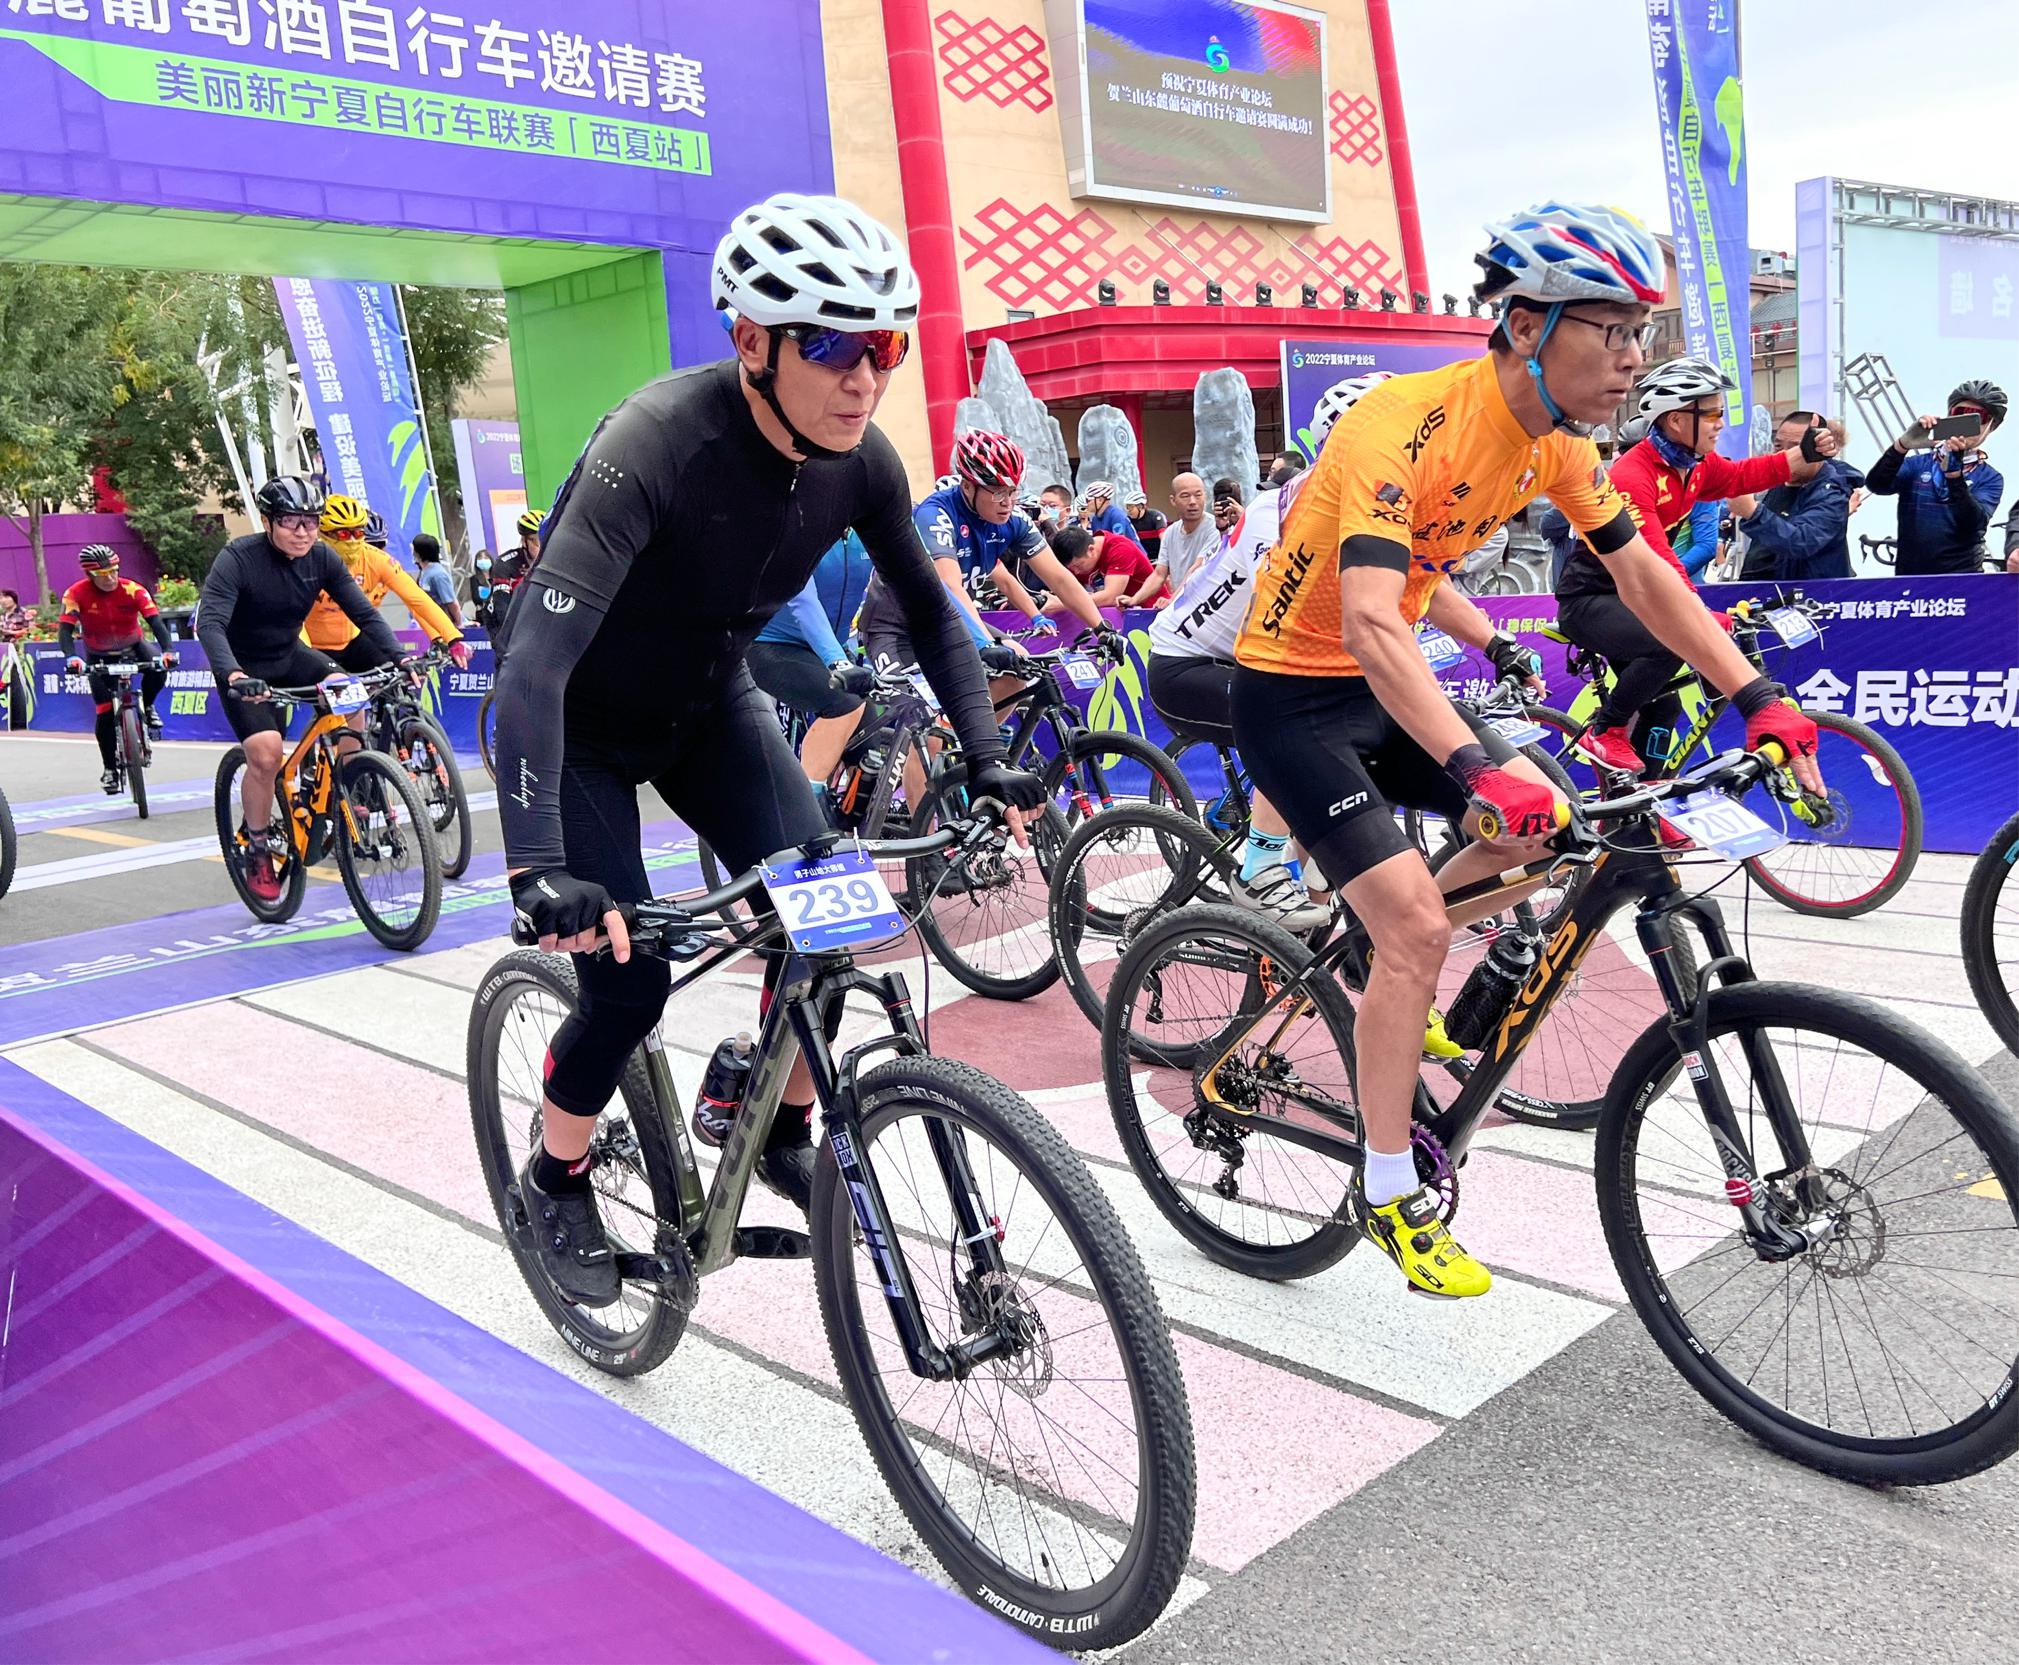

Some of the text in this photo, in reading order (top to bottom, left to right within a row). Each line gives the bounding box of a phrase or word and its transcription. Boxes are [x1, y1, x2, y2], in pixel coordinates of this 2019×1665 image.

[717, 266, 739, 293] PMT
[1174, 569, 1248, 640] TREK
[1262, 542, 1316, 639] Santic
[1780, 614, 1807, 639] 213
[1423, 640, 1455, 660] 240
[1070, 664, 1095, 679] 241
[1668, 705, 1715, 770] GIANT
[1687, 807, 1751, 840] 207
[788, 879, 879, 925] 239
[1049, 1614, 1093, 1634] WTB
